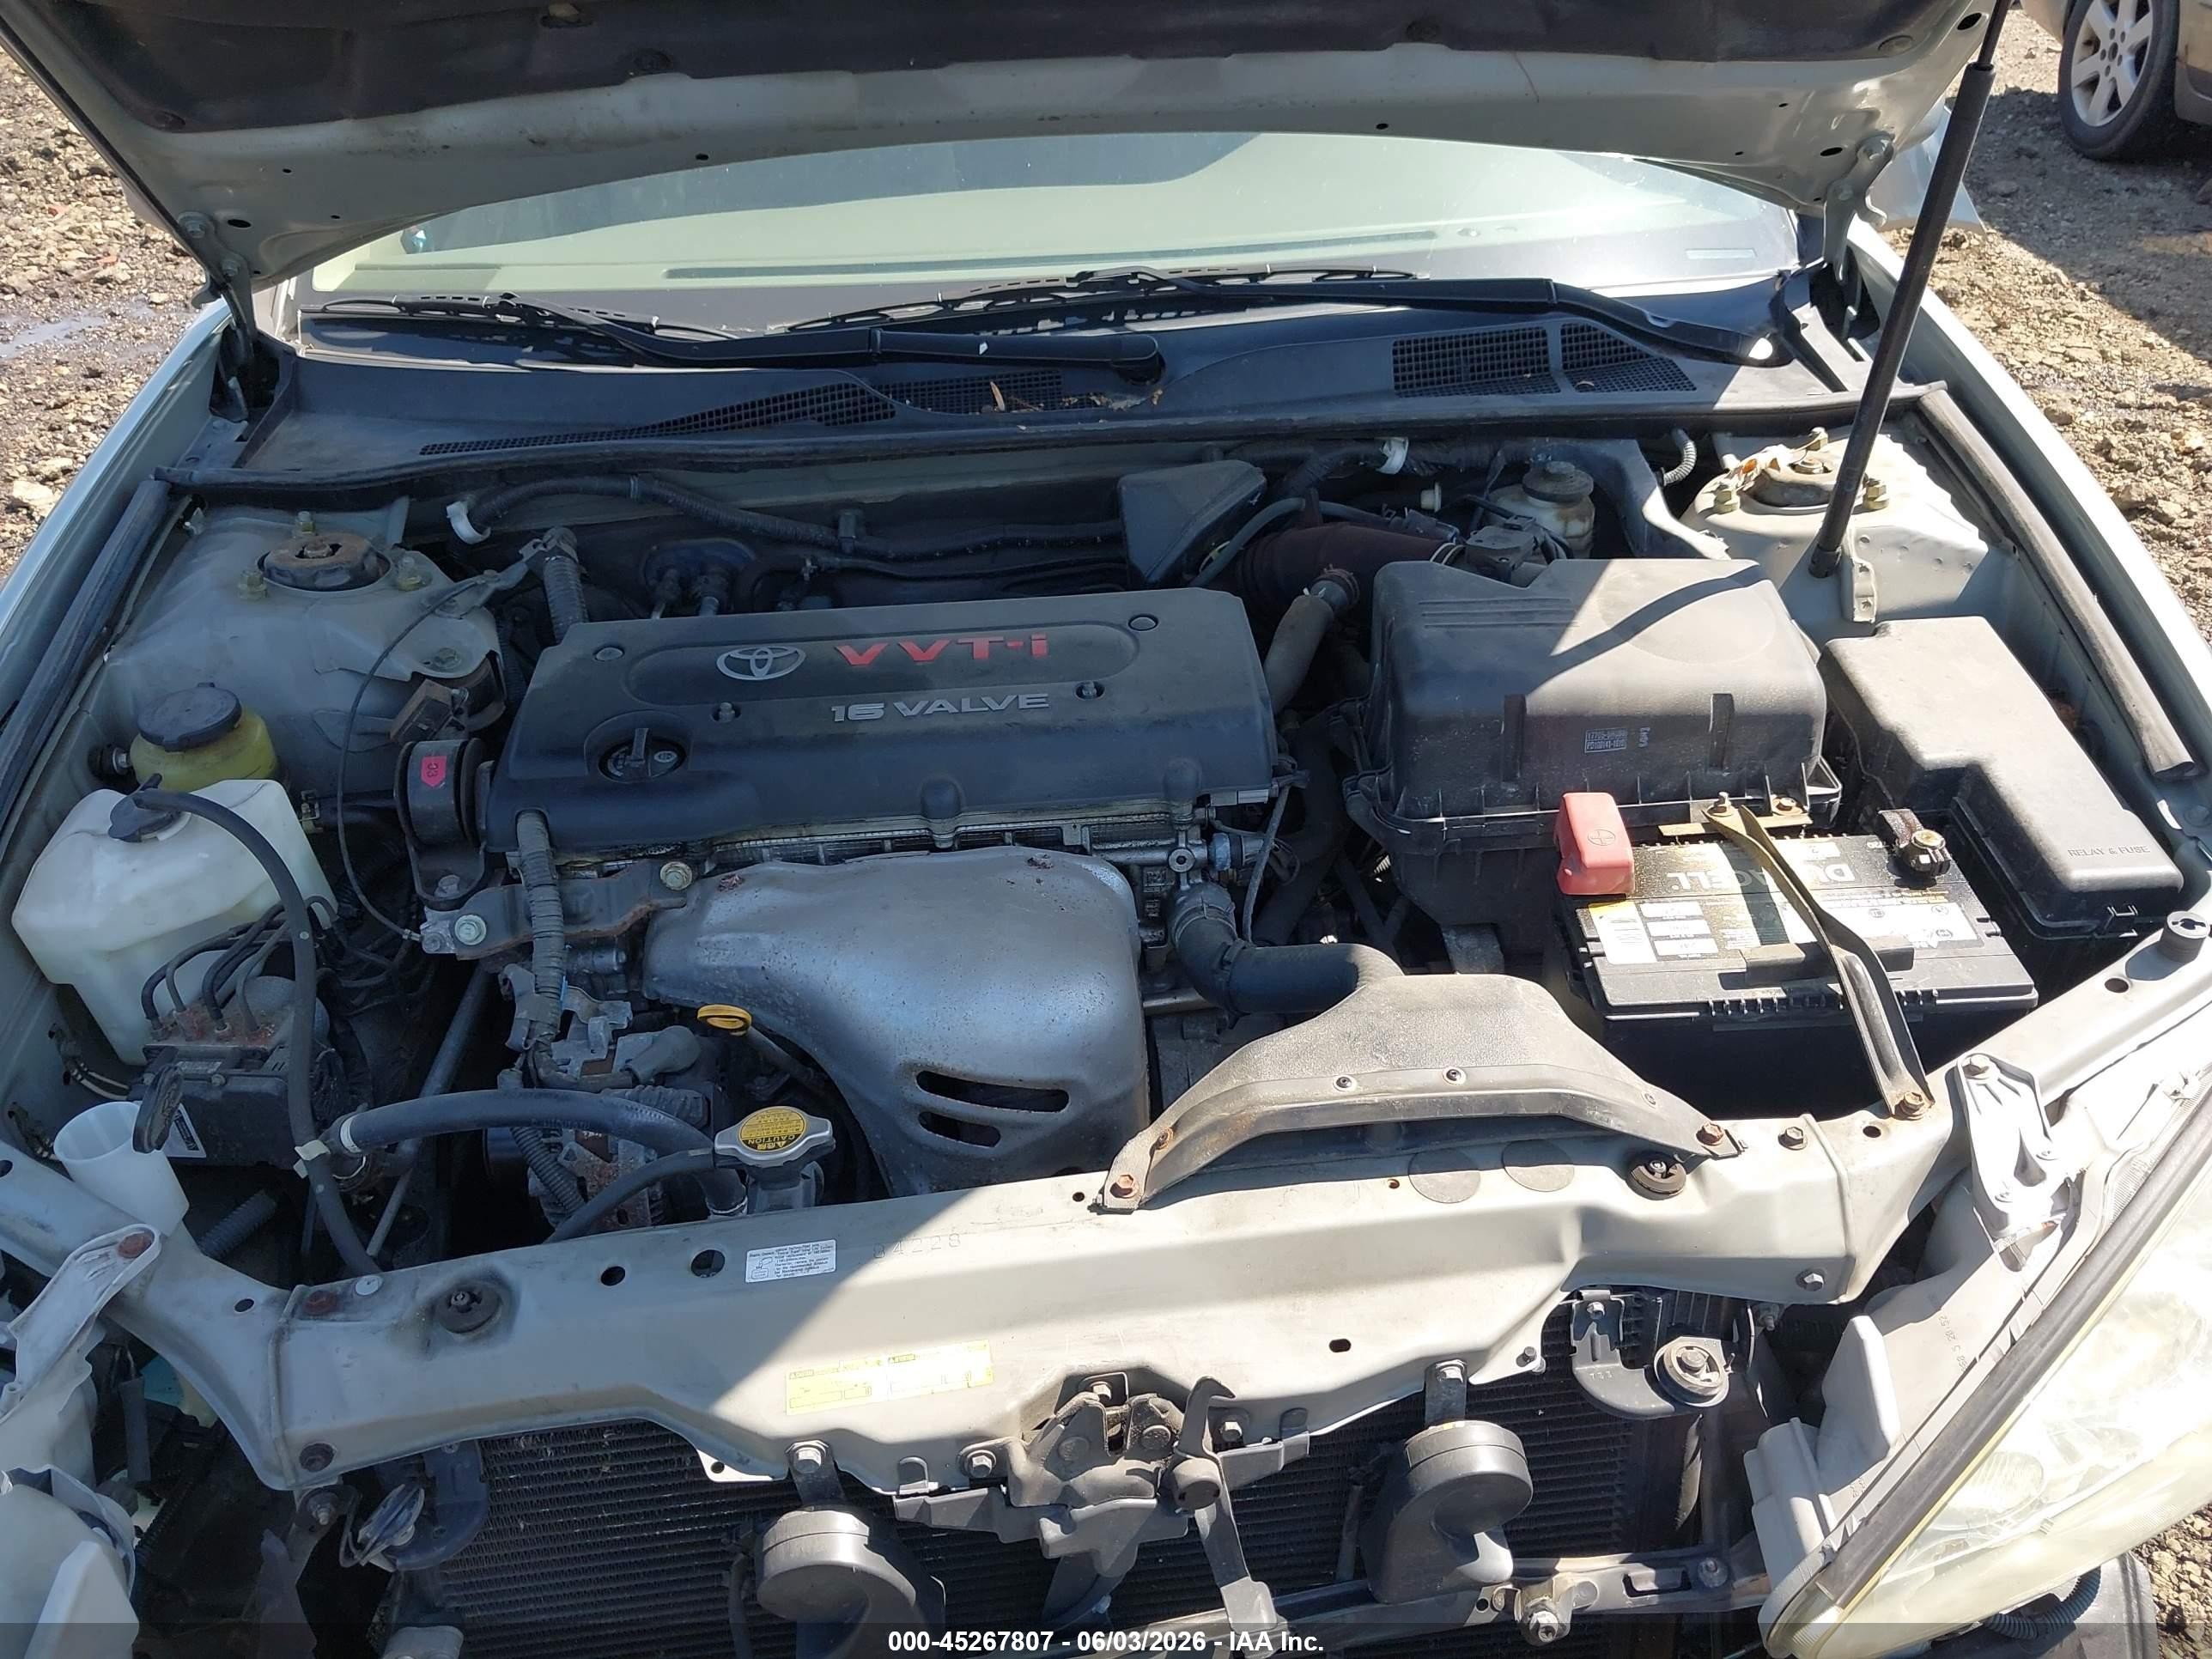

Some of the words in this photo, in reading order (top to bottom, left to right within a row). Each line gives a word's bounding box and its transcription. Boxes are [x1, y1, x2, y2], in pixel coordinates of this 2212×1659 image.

[835, 634, 1048, 666] VVT-i
[831, 702, 885, 722] 16
[893, 693, 1049, 717] VALVE
[2068, 847, 2105, 857] RELAY
[2118, 845, 2151, 854] FUSE
[748, 1134, 795, 1145] CAUTION
